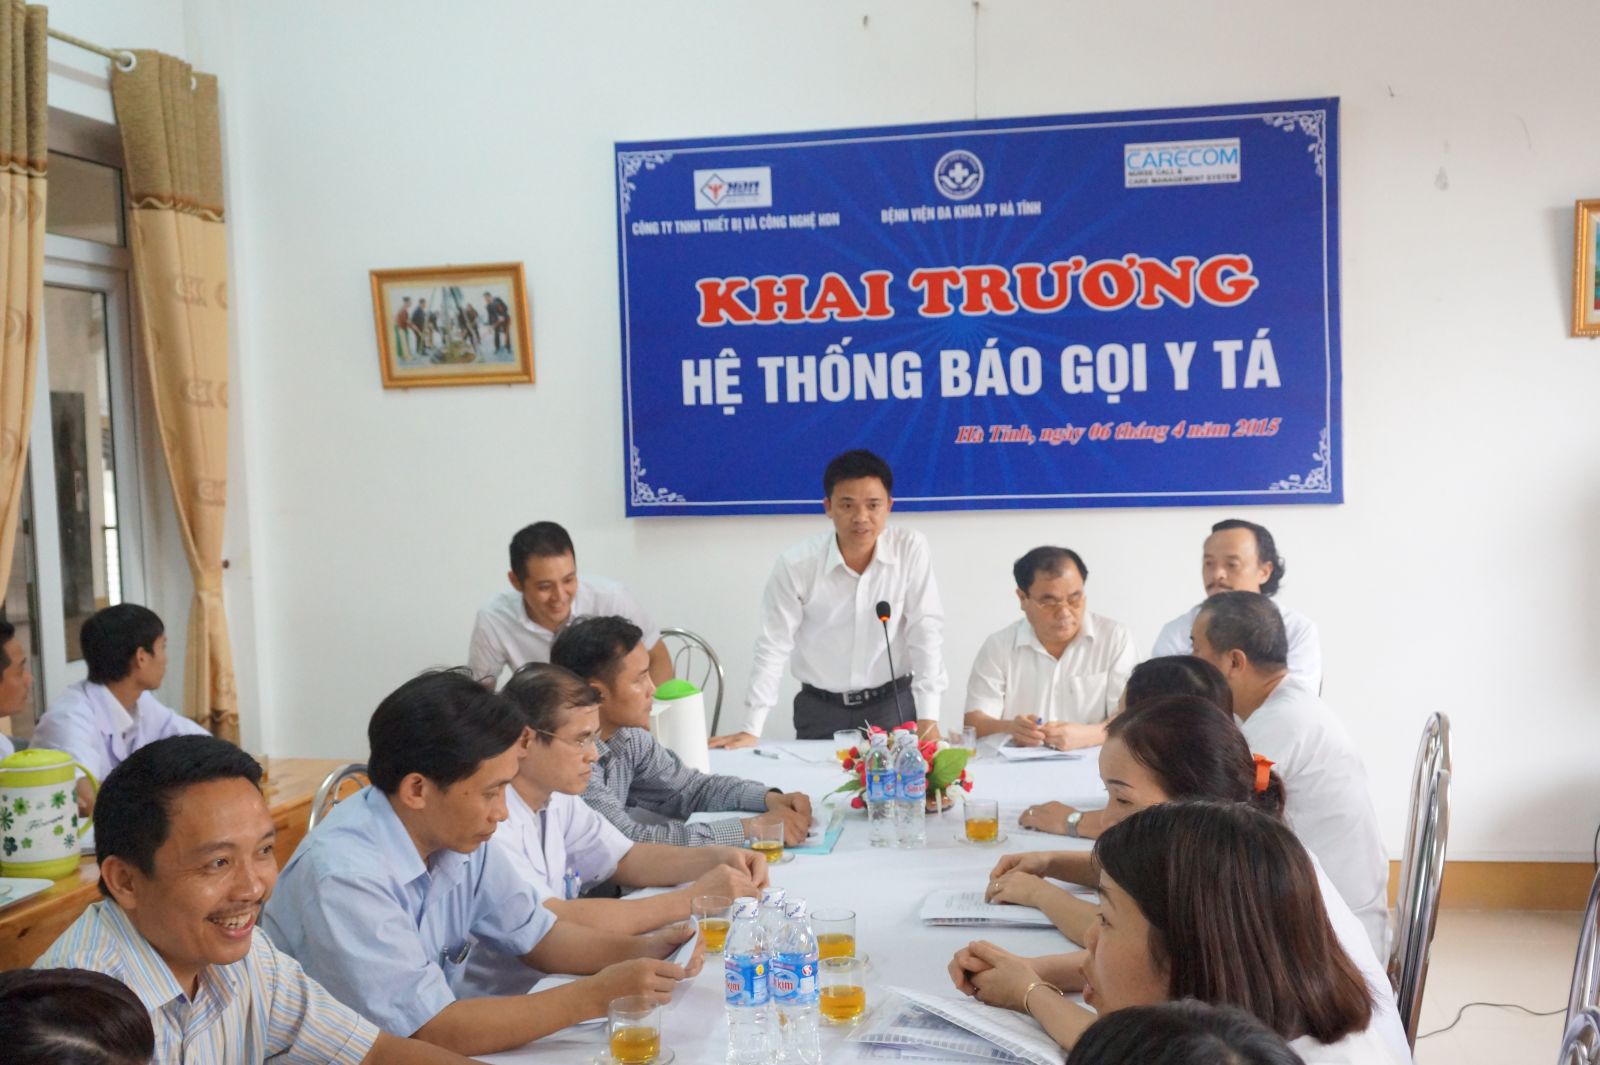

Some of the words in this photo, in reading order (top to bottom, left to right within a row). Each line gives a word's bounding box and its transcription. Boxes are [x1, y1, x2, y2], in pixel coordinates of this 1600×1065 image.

[1126, 147, 1238, 170] CARECOM
[632, 219, 660, 236] CÔNG
[661, 220, 673, 235] TY
[674, 219, 702, 234] TNHH
[743, 214, 758, 231] VÀ
[759, 212, 788, 231] CÔNG
[881, 207, 909, 225] BỆNH
[911, 205, 936, 224] VIỆN
[953, 204, 983, 219] KHOA
[984, 203, 998, 218] TP
[1000, 199, 1015, 216] HÀ
[695, 270, 895, 328] KHAI
[909, 253, 1259, 317] TRƯƠNG
[681, 347, 743, 416] HỆ
[757, 336, 923, 403] THỐNG
[940, 337, 1043, 398] BÁO
[1060, 342, 1148, 404] GỌI
[1164, 341, 1198, 391] Y
[1212, 327, 1282, 390] TÁ
[955, 425, 984, 444] Hà
[1038, 422, 1087, 446] ngày
[1087, 421, 1115, 441] 06
[1114, 420, 1170, 444] tháng
[1171, 419, 1187, 439] 4
[1186, 420, 1231, 439] năm
[1231, 416, 1283, 438] 2015
